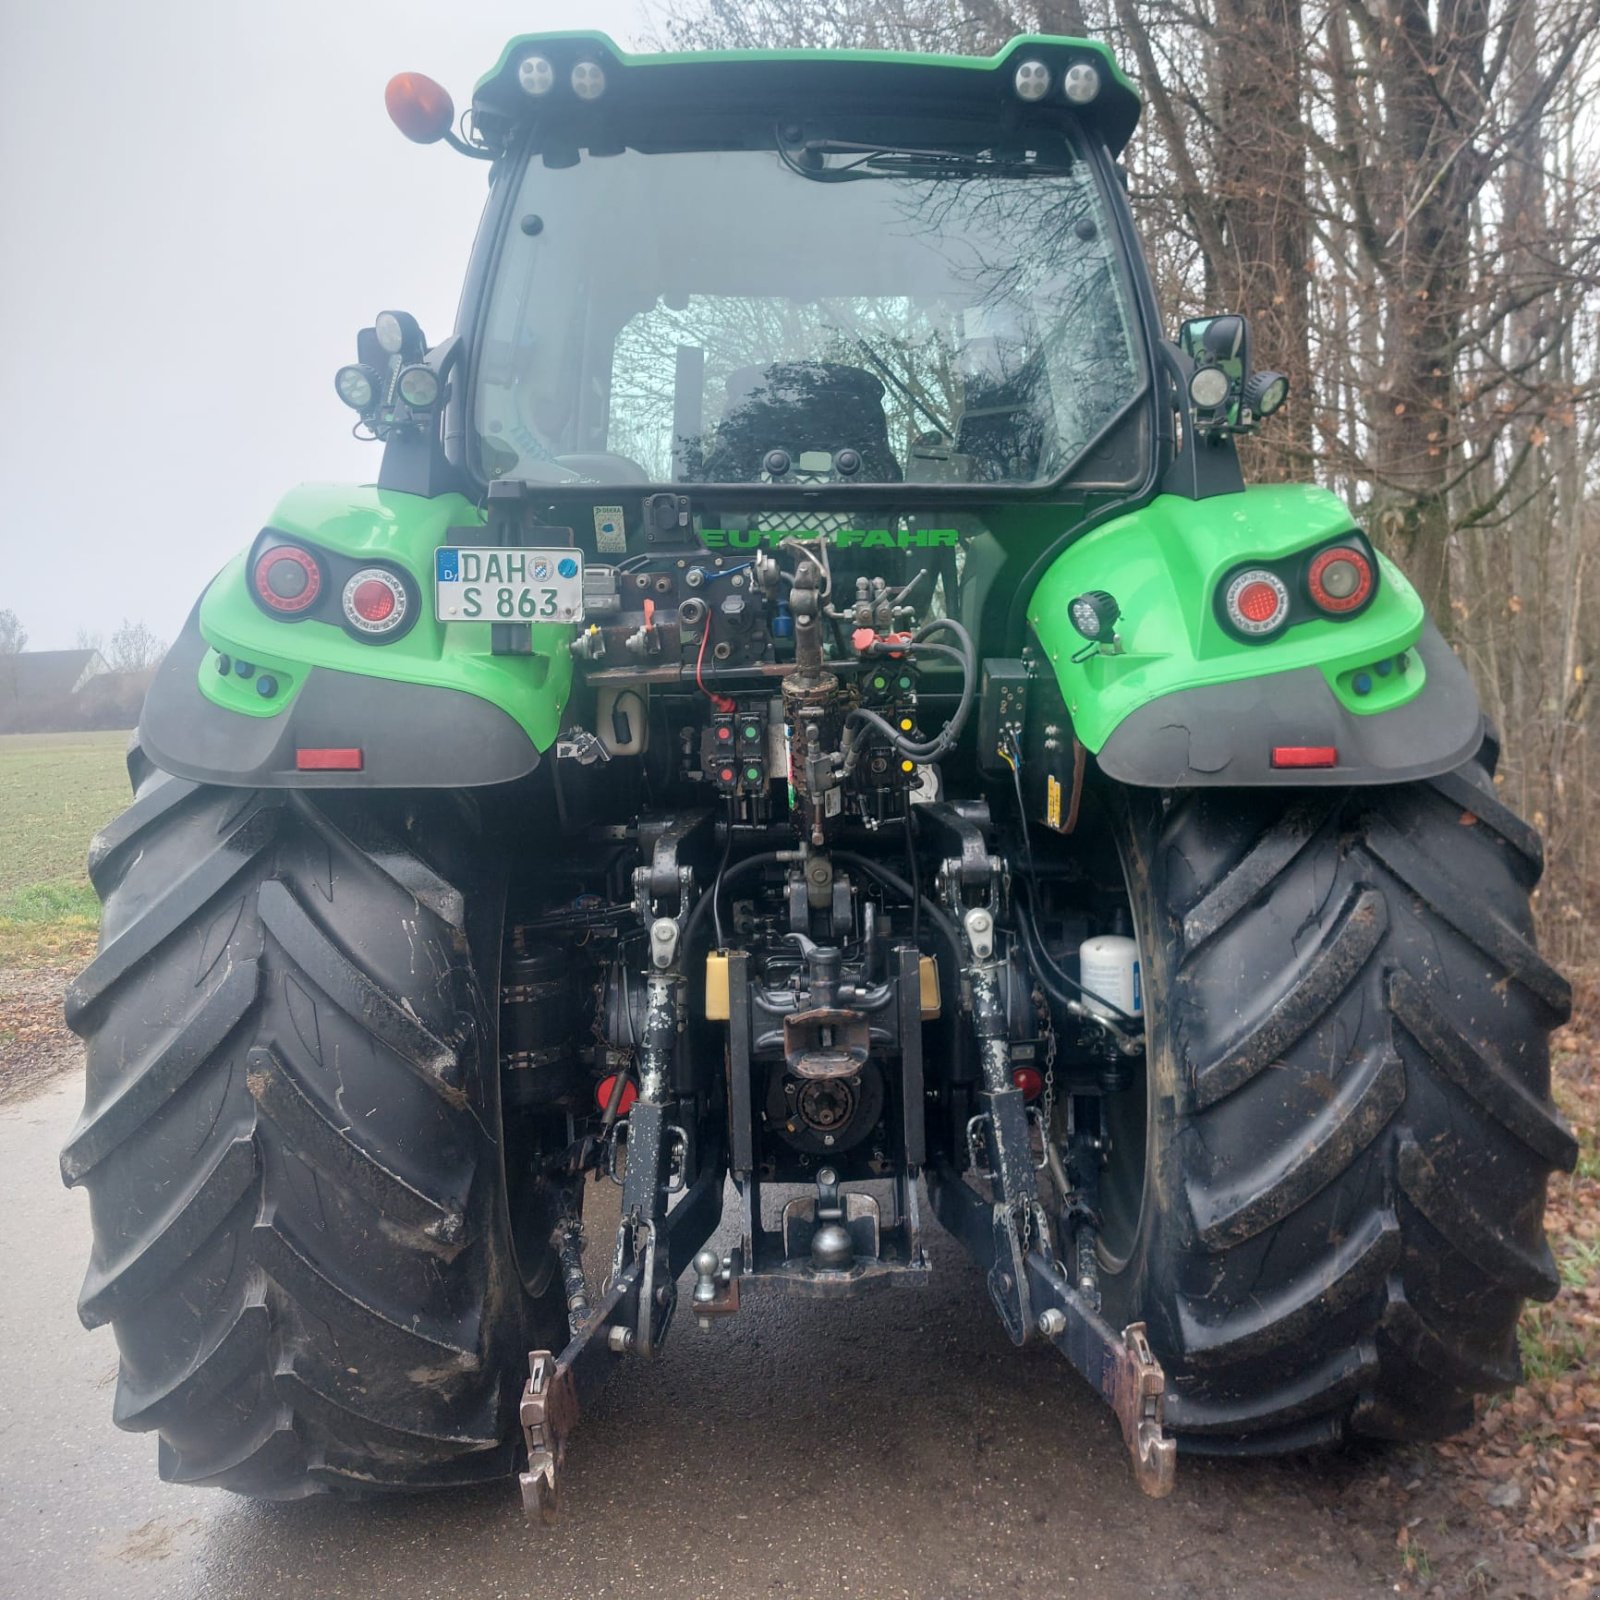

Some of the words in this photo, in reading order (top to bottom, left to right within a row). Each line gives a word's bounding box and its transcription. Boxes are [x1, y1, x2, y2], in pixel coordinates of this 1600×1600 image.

[836, 529, 959, 548] FAHR
[444, 569, 453, 580] D
[461, 553, 526, 583] DAH
[463, 587, 482, 617] S
[496, 587, 558, 618] 863
